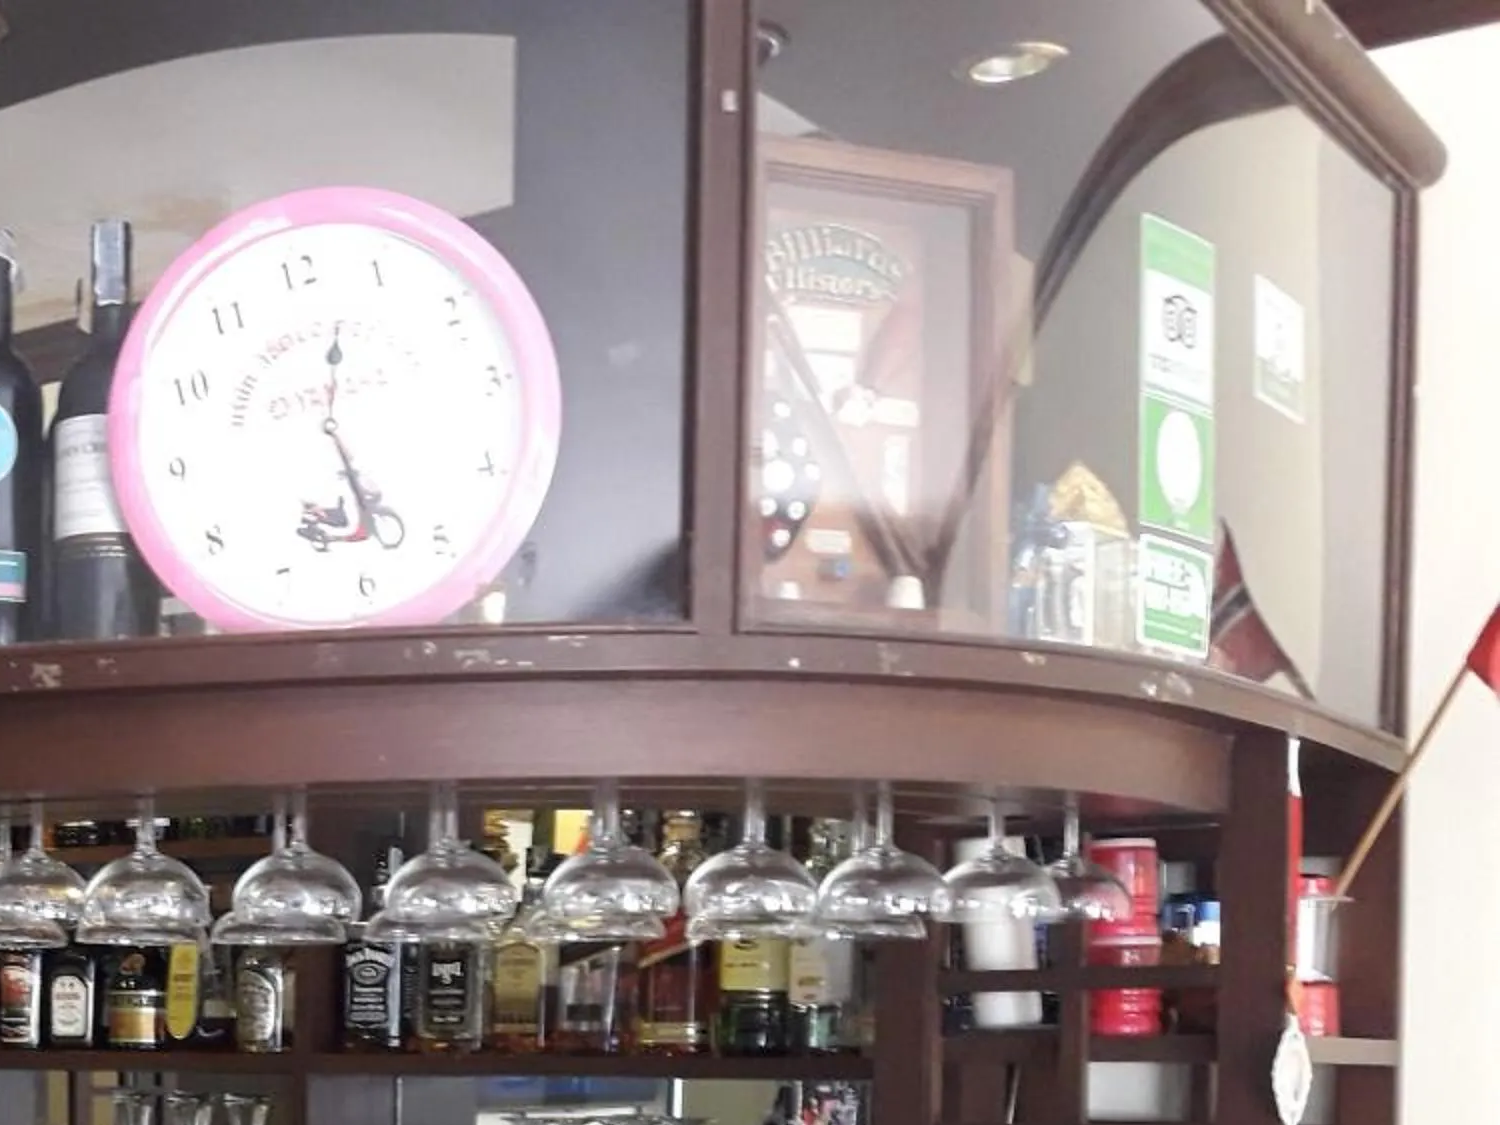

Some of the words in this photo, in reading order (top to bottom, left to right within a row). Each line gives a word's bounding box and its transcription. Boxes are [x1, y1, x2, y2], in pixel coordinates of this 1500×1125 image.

[282, 254, 317, 290] 12
[371, 259, 383, 287] 1
[211, 301, 244, 335] 11
[174, 370, 209, 406] 10
